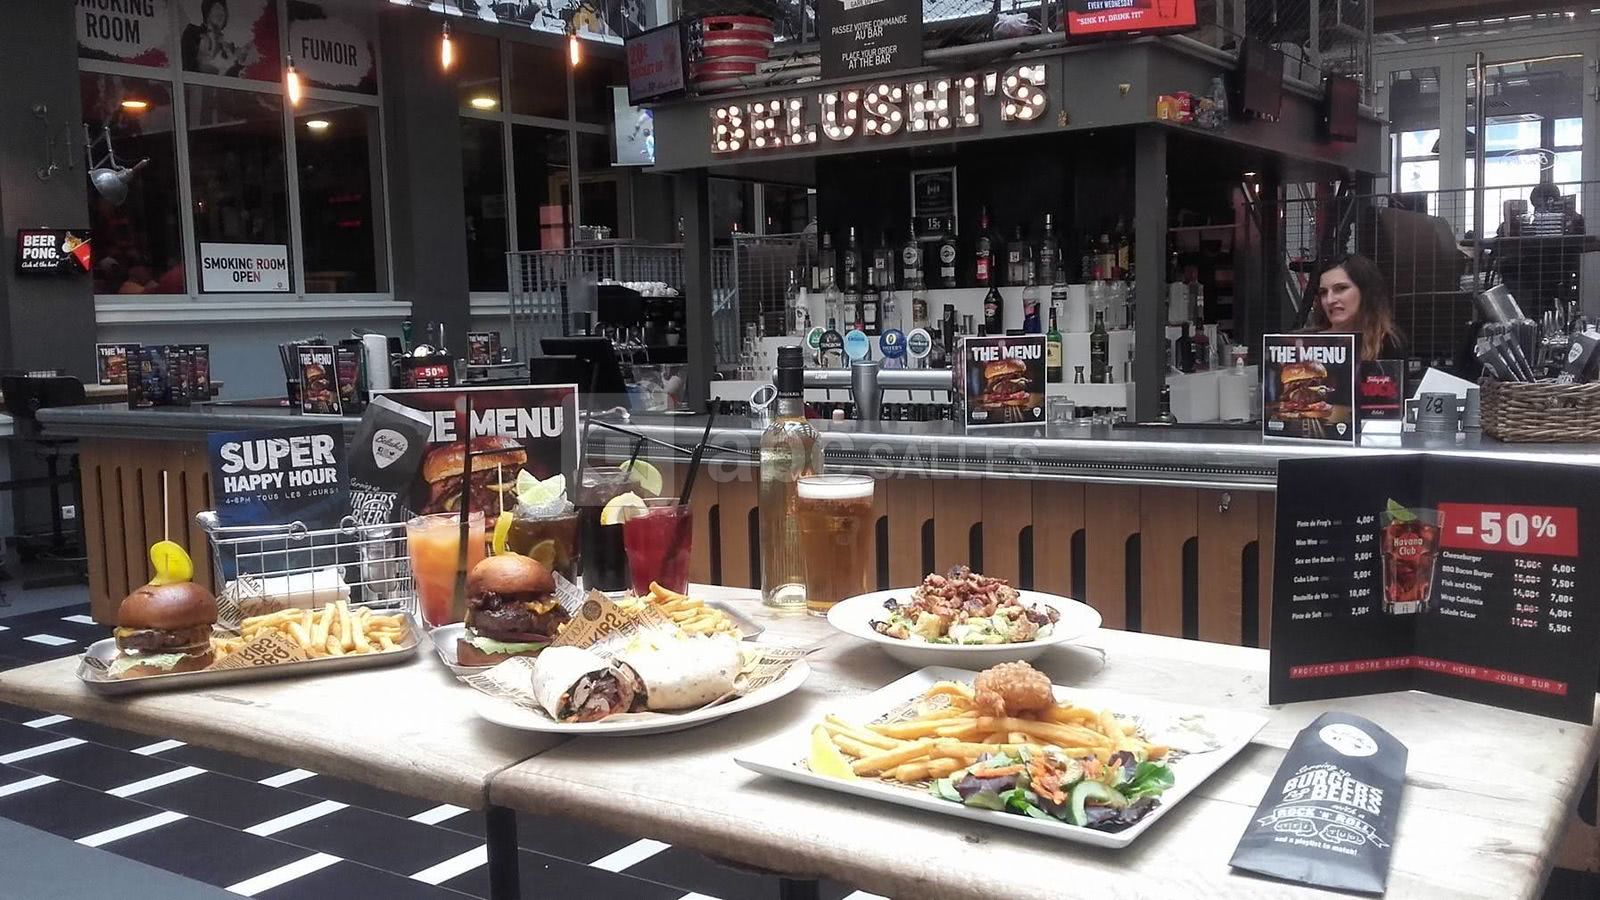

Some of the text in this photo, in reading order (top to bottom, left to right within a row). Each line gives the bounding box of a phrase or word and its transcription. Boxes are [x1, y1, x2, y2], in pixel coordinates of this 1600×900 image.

[75, 0, 154, 17] KING
[1109, 12, 1130, 22] DRINK
[85, 12, 140, 44] ROOM
[831, 14, 908, 35] PASSEZ VOTRE COMMANDE
[855, 27, 883, 40] AU BAR
[301, 37, 358, 67] FUMOIR
[842, 45, 898, 61] PLACE YOUR ORDER
[848, 54, 891, 70] AT THE BAR
[711, 64, 1046, 153] BELUSHI'S
[23, 235, 56, 247] BEER
[22, 247, 60, 259] PONG.
[203, 257, 286, 270] SMOKING ROOM
[232, 270, 262, 282] OPEN
[100, 347, 115, 356] THE
[971, 345, 1042, 362] THE MENU
[1269, 346, 1346, 364] THE MENU
[300, 353, 332, 366] THE MENU
[420, 368, 444, 377] -50%
[471, 407, 564, 440] MENU
[220, 434, 336, 473] SUPER
[223, 467, 337, 493] HAPPY HOUR
[257, 493, 279, 502] TOUS
[285, 491, 302, 499] LES
[349, 491, 398, 509] URGERS
[1456, 512, 1557, 546] -50%
[1394, 538, 1423, 547] Havana
[1399, 546, 1416, 556] Club
[1442, 551, 1482, 562] Cheeseburger
[1473, 569, 1494, 579] Burger
[1441, 579, 1482, 591] Fish and Chips
[1551, 578, 1575, 588] 7,50€
[1456, 596, 1483, 606] California
[1550, 593, 1574, 603] 7,00€
[1440, 608, 1459, 616] Salade
[1548, 622, 1572, 633] 5,50€
[1418, 660, 1447, 670] HAPPY
[1453, 666, 1477, 675] HOUR
[1496, 674, 1525, 685] JOURS
[1532, 680, 1550, 689] SUR
[1282, 769, 1384, 796] BURGERS
[1311, 785, 1382, 815] BEERS
[1277, 807, 1315, 818] ROCK
[1335, 813, 1370, 835] ROLL
